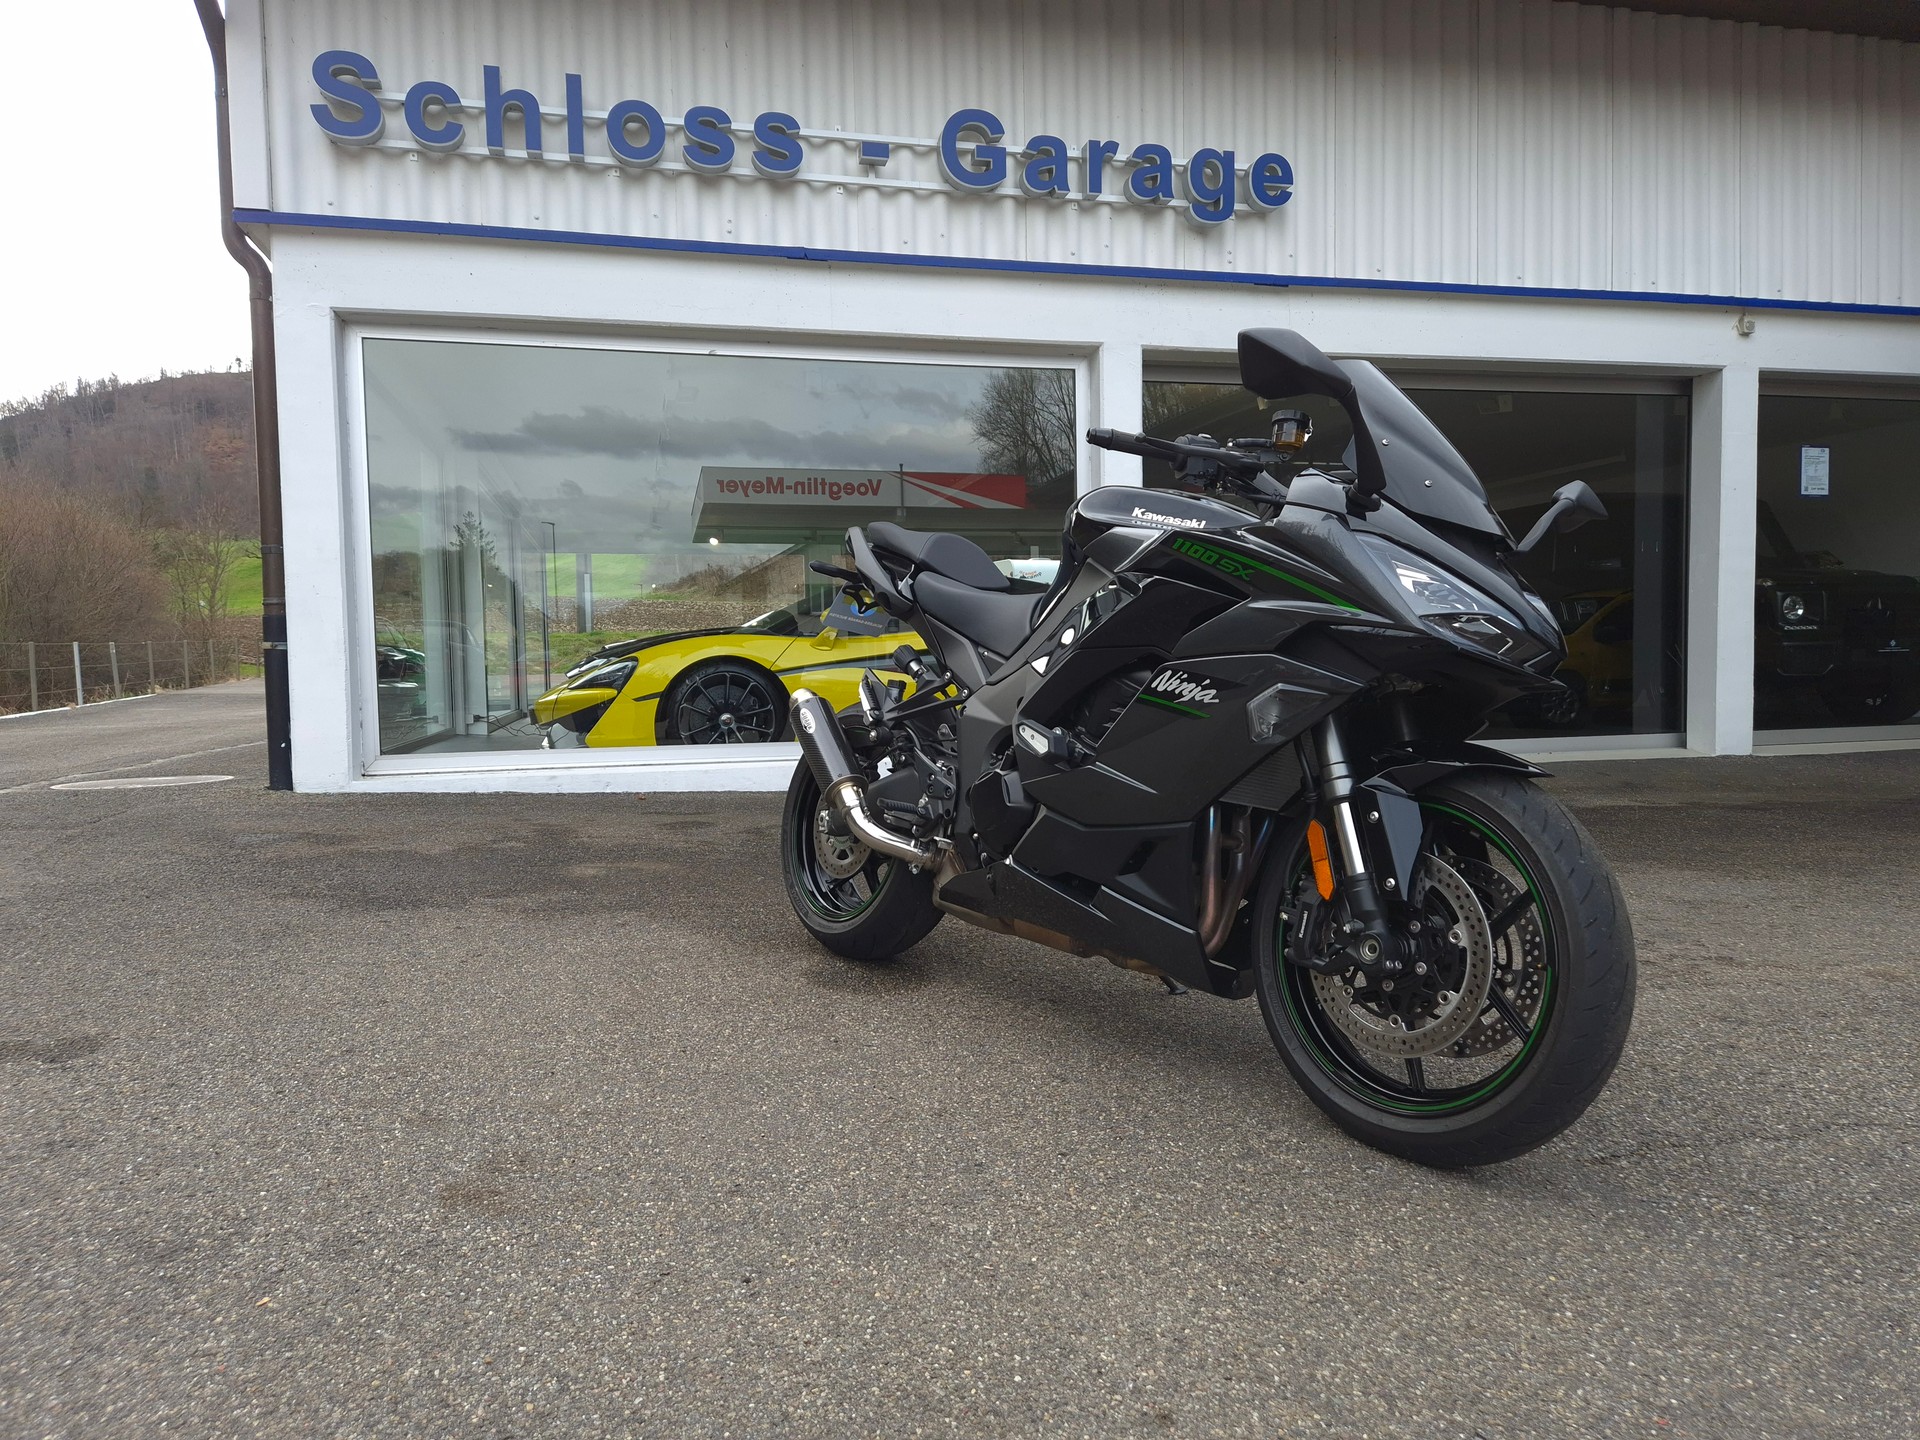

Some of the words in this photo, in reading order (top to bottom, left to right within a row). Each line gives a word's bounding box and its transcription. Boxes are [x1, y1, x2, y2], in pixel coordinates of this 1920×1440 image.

[310, 50, 804, 176] Schloss
[938, 107, 1294, 224] Garage
[1131, 506, 1206, 529] Kawasaki
[1172, 538, 1219, 565] 1100
[1217, 558, 1255, 581] SX
[1150, 669, 1220, 703] Ninja
